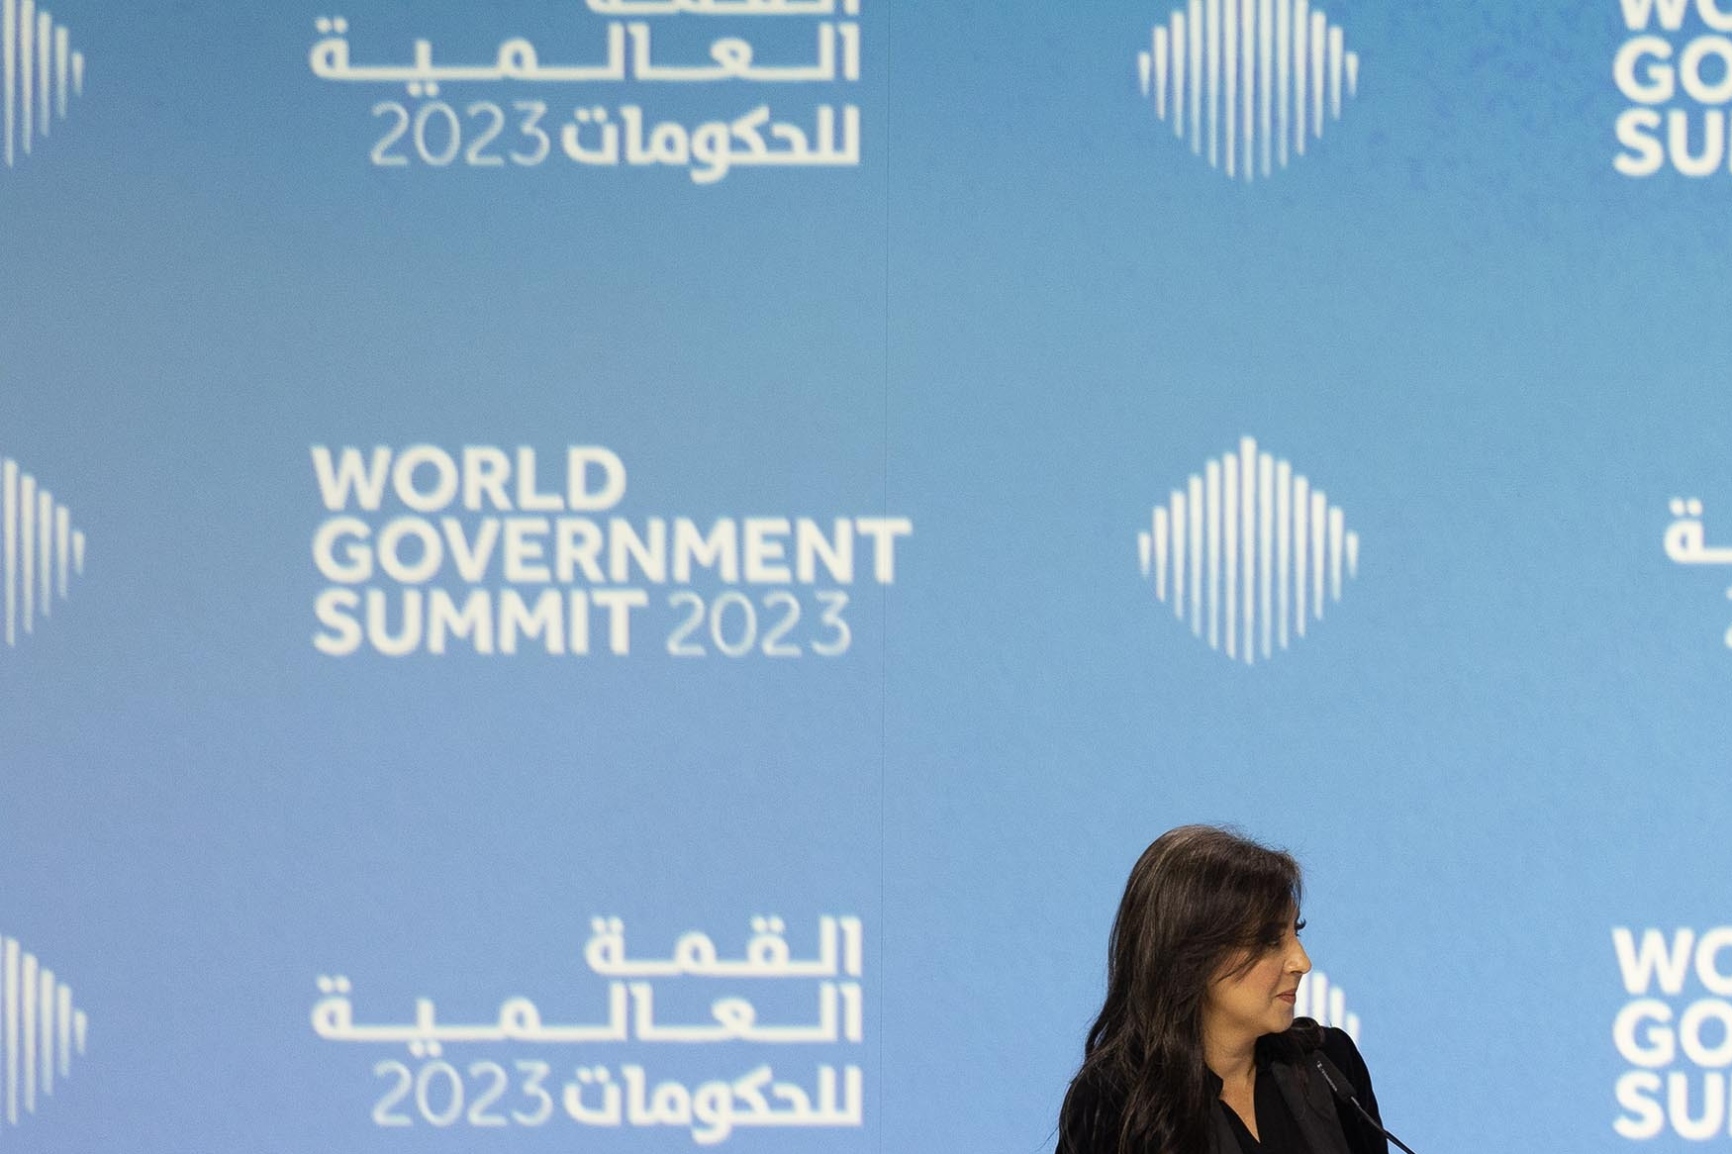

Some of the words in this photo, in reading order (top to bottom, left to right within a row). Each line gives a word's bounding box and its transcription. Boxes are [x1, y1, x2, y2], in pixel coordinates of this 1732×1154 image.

[310, 18, 860, 96] العالمية
[370, 101, 550, 166] 2023
[562, 106, 860, 184] للحكومات
[312, 445, 626, 512] WORLD
[313, 517, 912, 583] GOVERNMENT
[315, 589, 648, 655] SUMMIT
[667, 591, 851, 656] 2023
[586, 917, 862, 977] القمة
[312, 976, 862, 1057] العالمية
[373, 1061, 553, 1127] 2023
[564, 1066, 862, 1145] للحكومات
